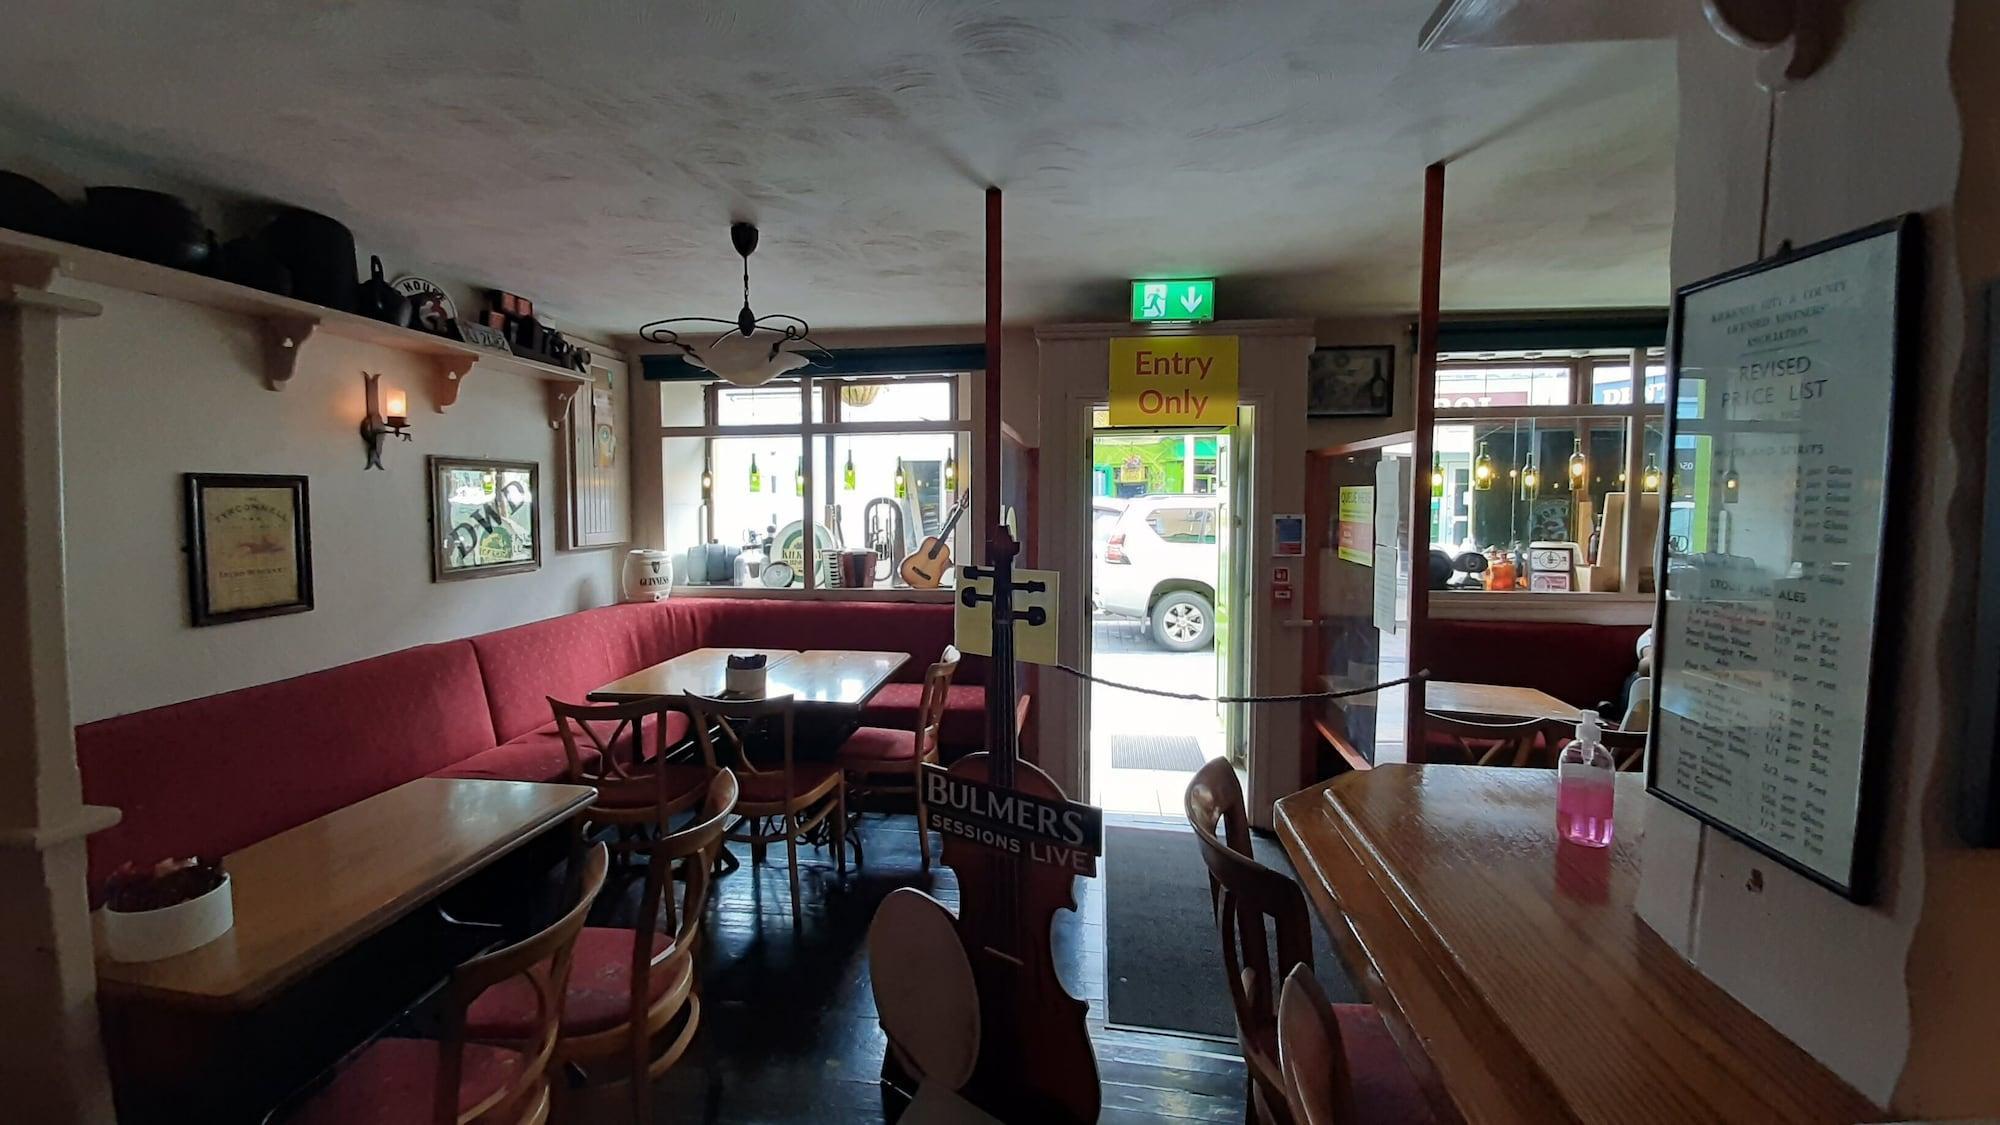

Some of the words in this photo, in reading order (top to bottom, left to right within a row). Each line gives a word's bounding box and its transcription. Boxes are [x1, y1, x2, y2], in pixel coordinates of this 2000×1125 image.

[1135, 351, 1214, 381] Entry
[1739, 356, 1812, 382] REVISED
[1138, 389, 1210, 419] Only
[1721, 386, 1775, 409] PRICE
[1789, 378, 1829, 402] LIST
[448, 480, 525, 559] DWD
[640, 577, 670, 586] GUINNESS
[1778, 589, 1808, 604] ALES
[927, 772, 1084, 846] BULMERS
[931, 814, 1021, 854] SESSIONS
[1029, 841, 1089, 871] LIVE
